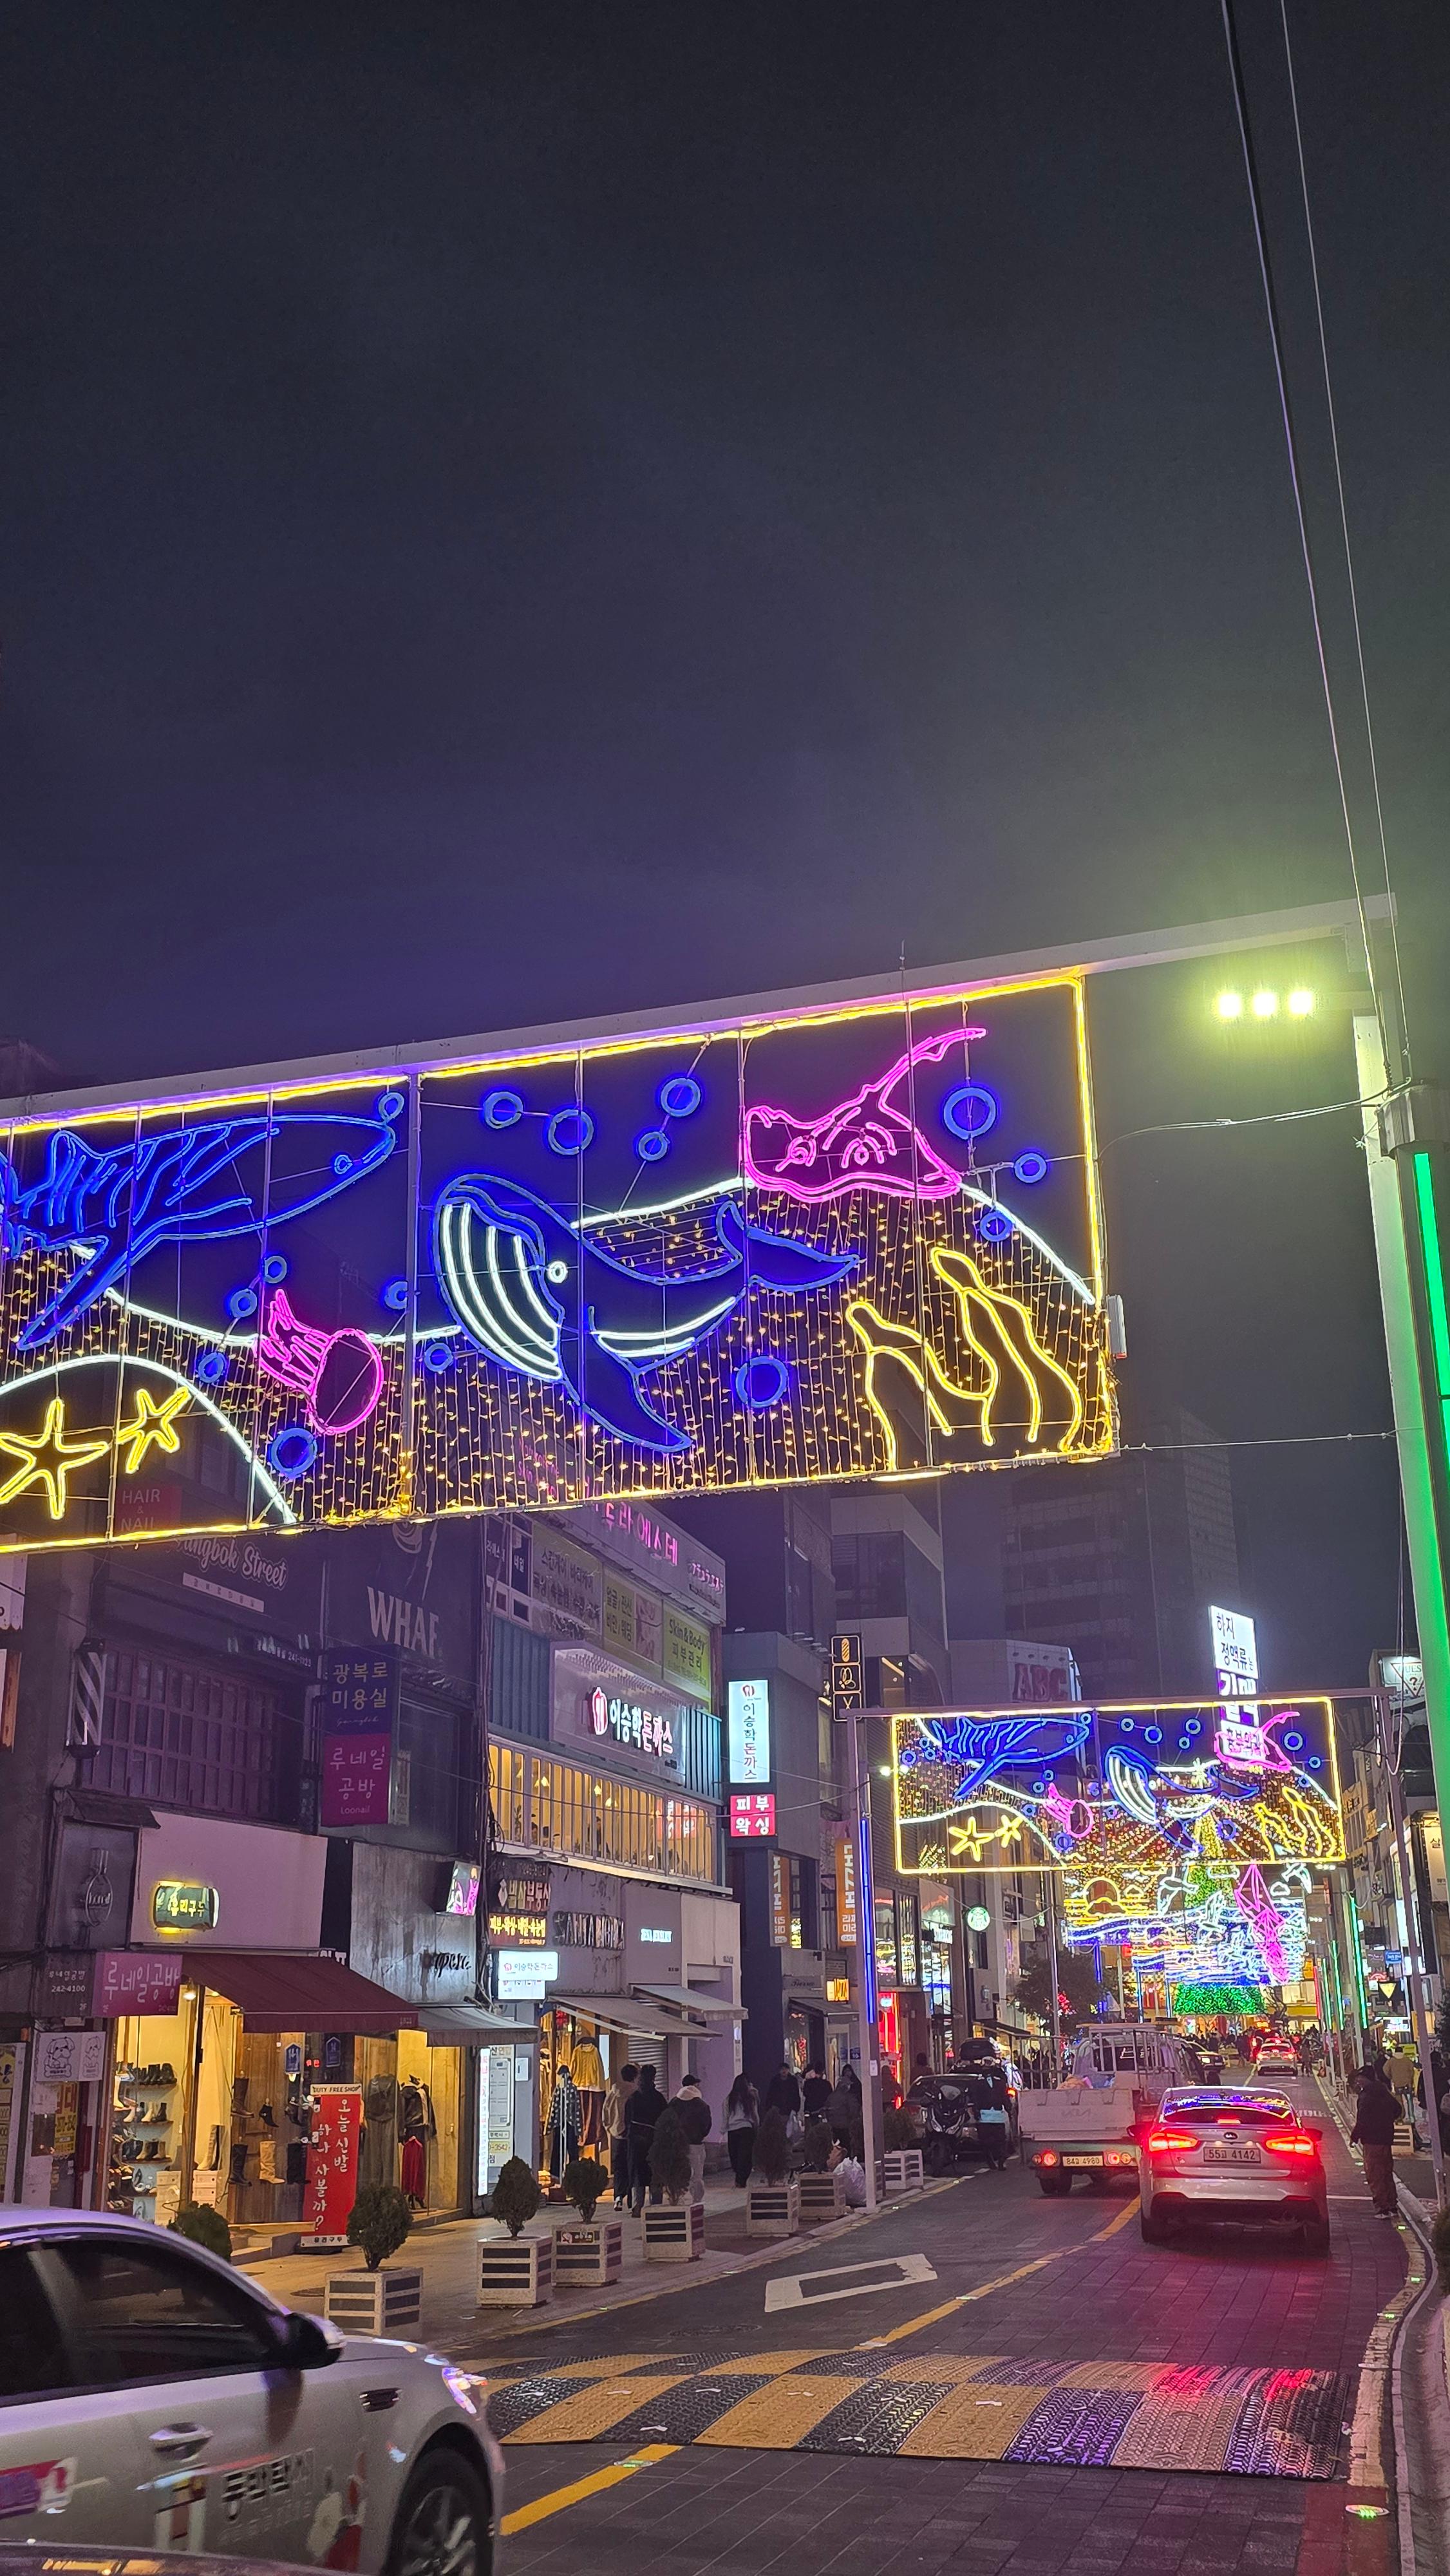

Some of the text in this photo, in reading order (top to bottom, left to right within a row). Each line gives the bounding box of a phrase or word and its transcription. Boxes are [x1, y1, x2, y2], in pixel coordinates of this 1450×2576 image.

[122, 1488, 160, 1504] HAIR
[241, 1546, 287, 1587] Street
[669, 1618, 706, 1656] Skin&Body
[332, 1661, 388, 1685] 광복로
[1012, 1663, 1069, 1702] ABC
[332, 1687, 387, 1710] 미용실
[609, 1698, 673, 1757] 이승학돈까스
[743, 1702, 758, 1780] 이승학돈까스
[329, 1746, 386, 1770] 루네일
[338, 1777, 376, 1800] 공방
[340, 1805, 371, 1814] Loonail
[735, 1795, 770, 1812] 피부
[735, 1817, 770, 1835] 왁싱
[104, 1961, 181, 2003] 루네일공방
[334, 2098, 351, 2173] 오늘 신발
[1231, 2150, 1256, 2161] 4142
[312, 2163, 330, 2231] 사볼까?
